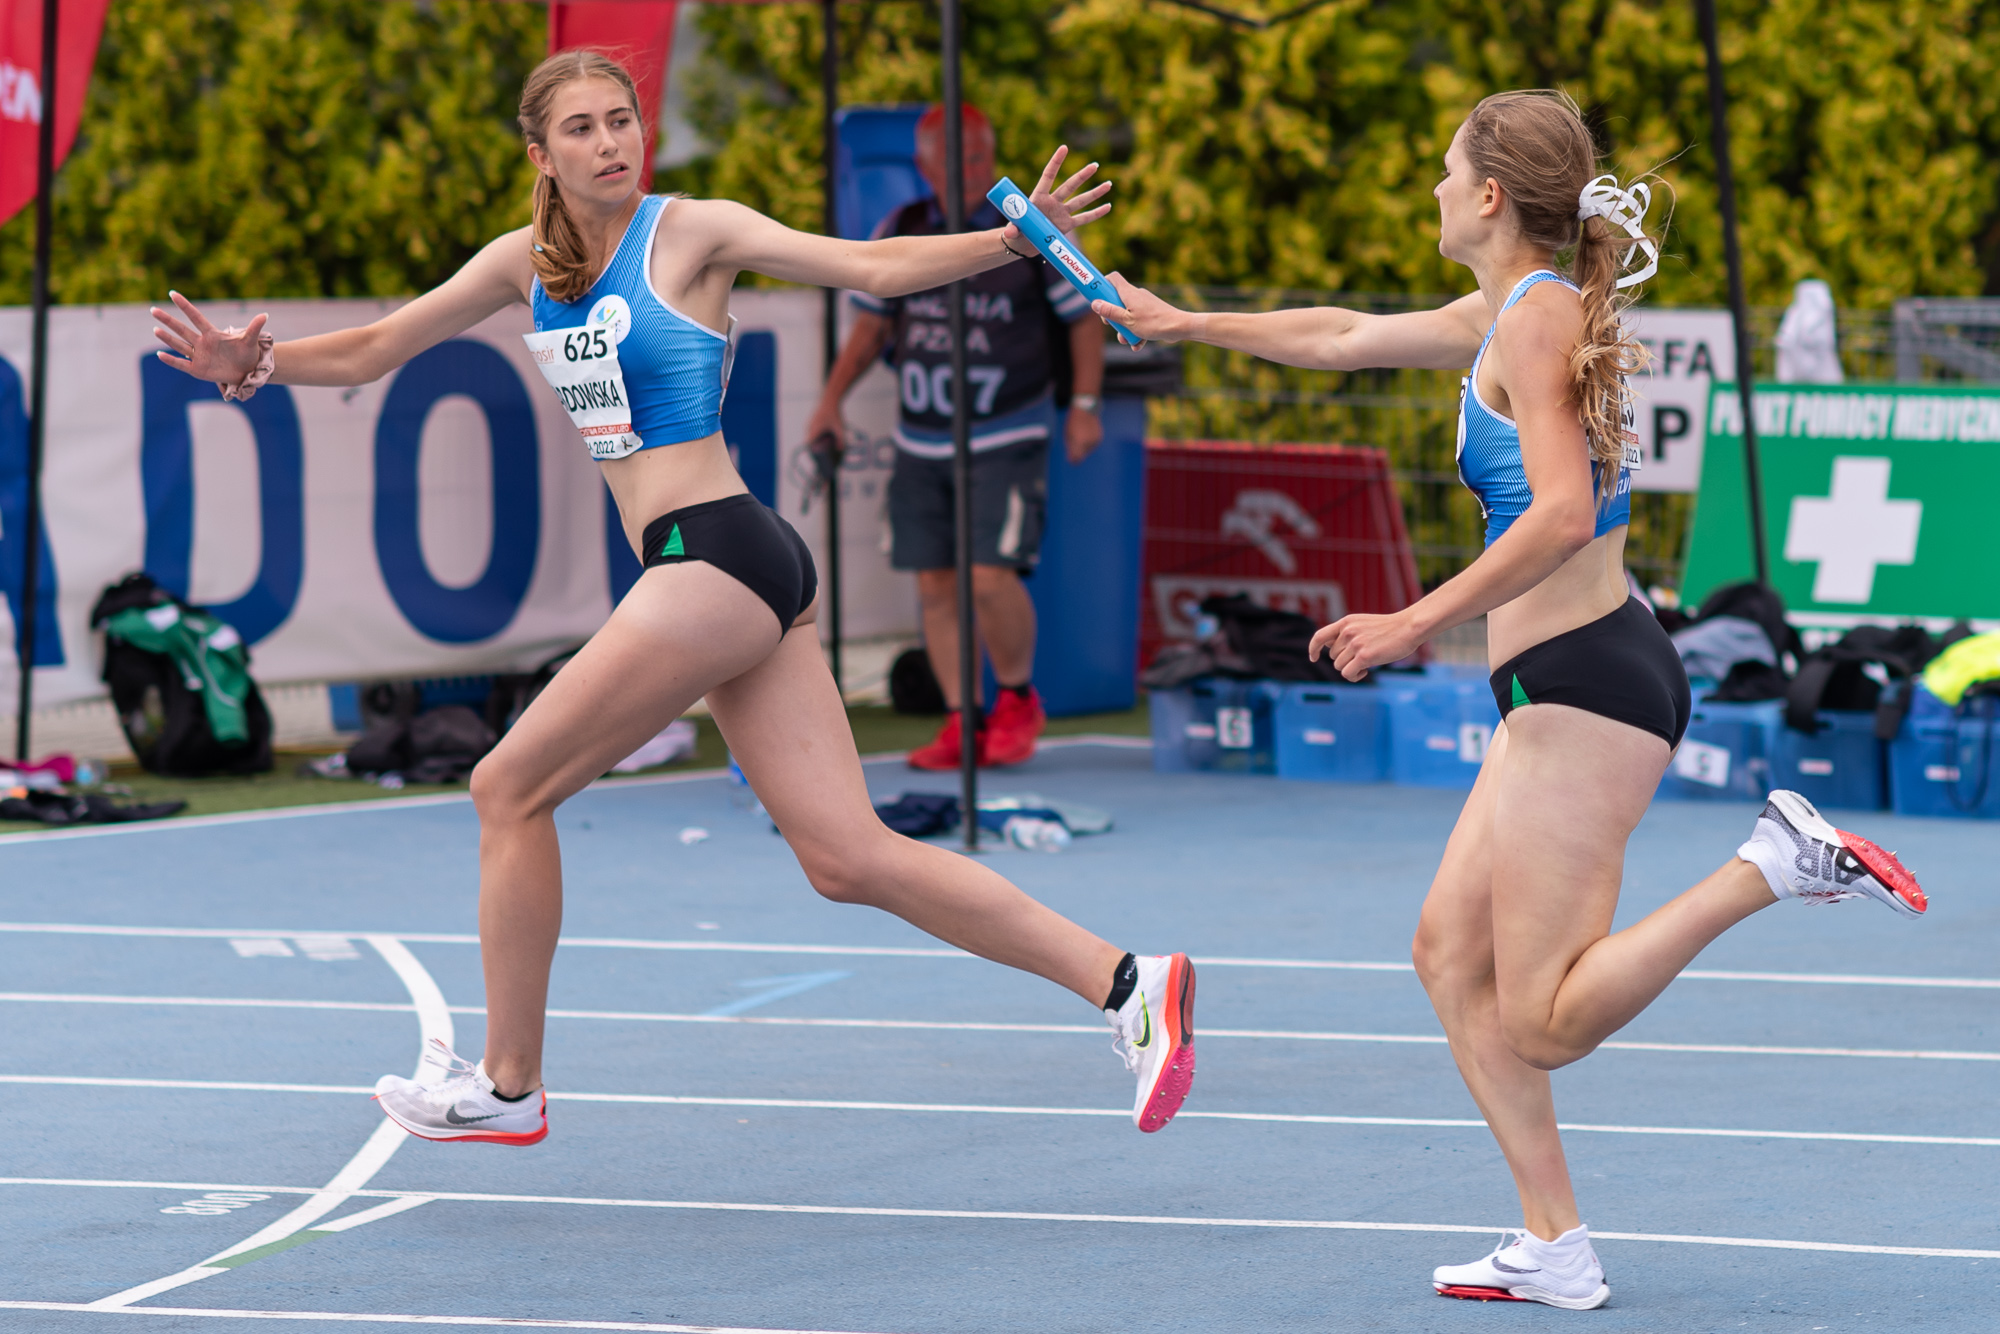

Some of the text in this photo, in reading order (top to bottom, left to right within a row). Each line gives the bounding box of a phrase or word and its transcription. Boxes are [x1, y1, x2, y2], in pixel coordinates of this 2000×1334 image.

[1061, 253, 1090, 281] polanik
[904, 293, 1013, 323] MEIA
[564, 329, 608, 362] 625
[906, 323, 992, 355] PZA
[556, 379, 624, 412] DOWSKA
[901, 359, 1007, 417] 007
[1710, 390, 1790, 438] PUKT
[1790, 391, 1893, 440] POMOCY
[594, 440, 616, 454] 2022
